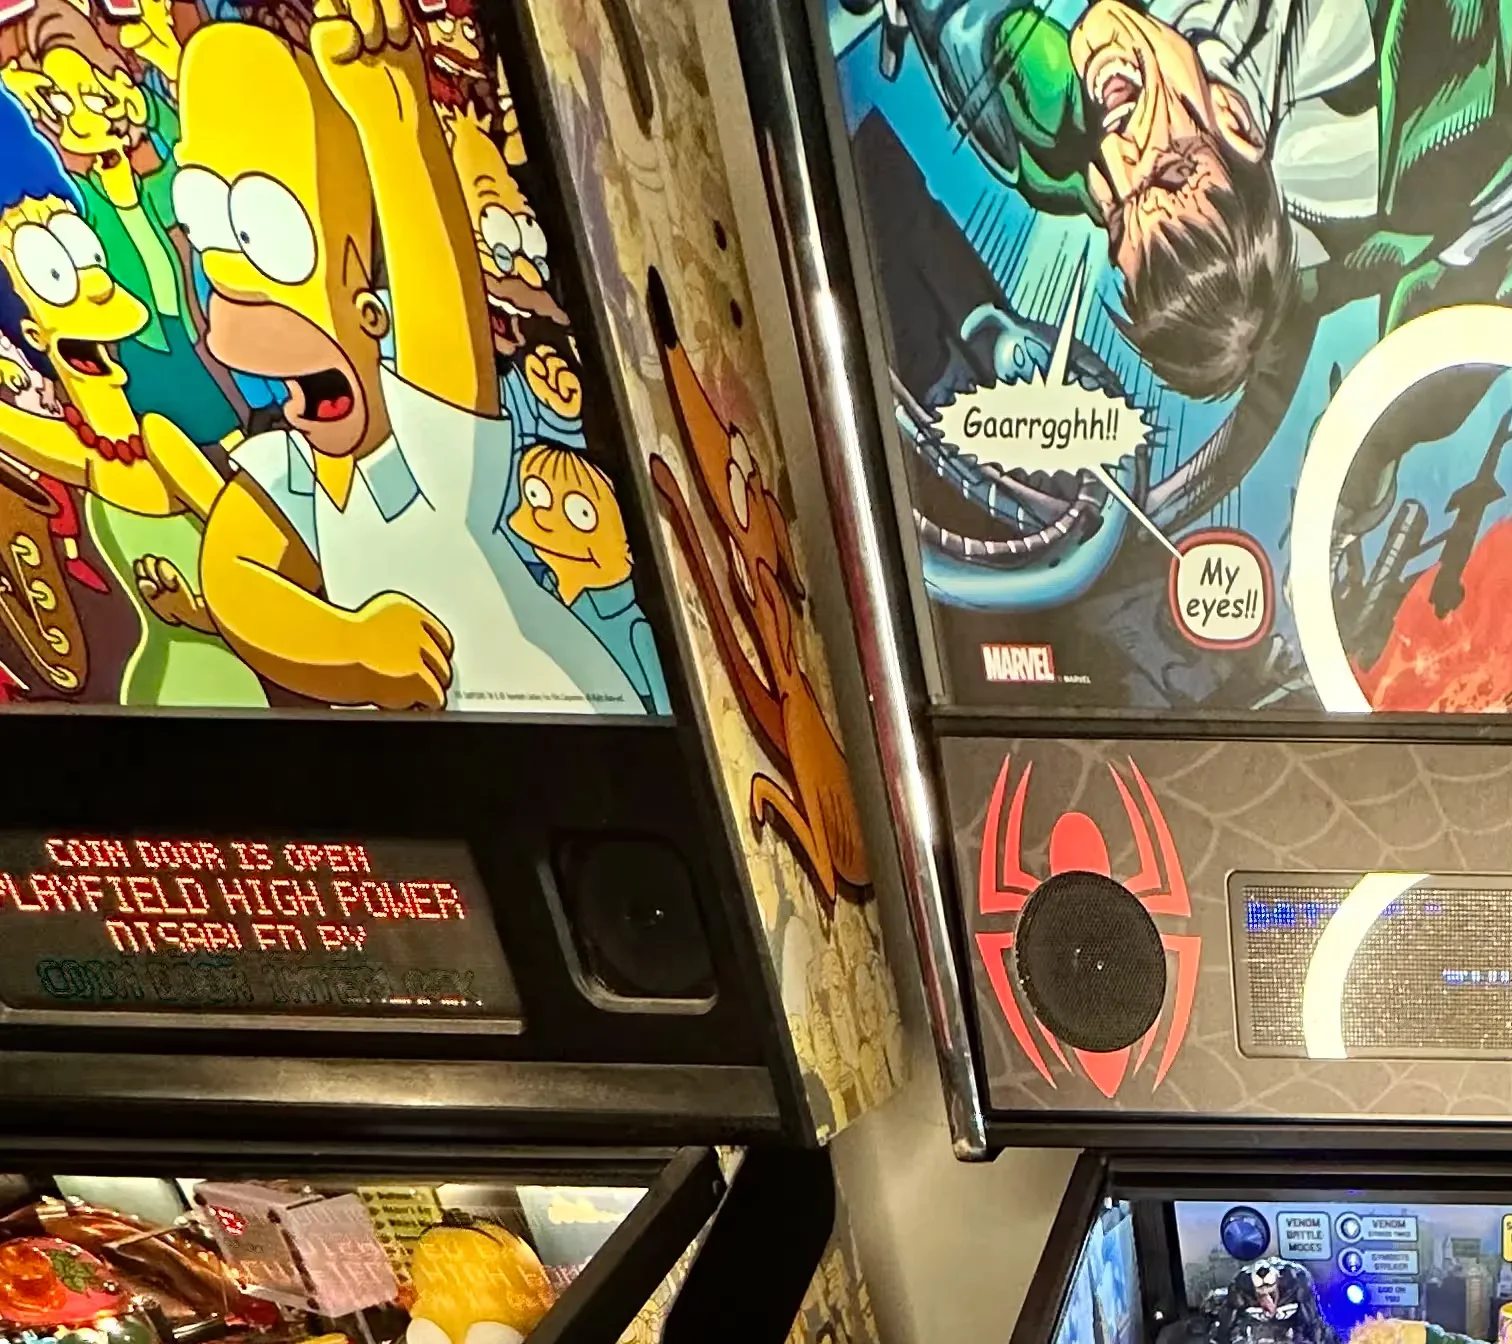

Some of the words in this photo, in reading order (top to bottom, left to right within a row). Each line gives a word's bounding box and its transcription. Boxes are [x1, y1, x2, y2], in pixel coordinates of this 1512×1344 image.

[964, 408, 1119, 448] Gaarrgghh!!
[1200, 557, 1239, 591] My
[1186, 595, 1256, 634] eyes!!
[983, 647, 1054, 681] MARVEL
[45, 839, 131, 868] COIN
[135, 839, 227, 870] DOOR
[230, 841, 273, 871] IS
[282, 843, 370, 873] OPEN
[217, 876, 325, 916] HIGH
[332, 879, 465, 919] POWER
